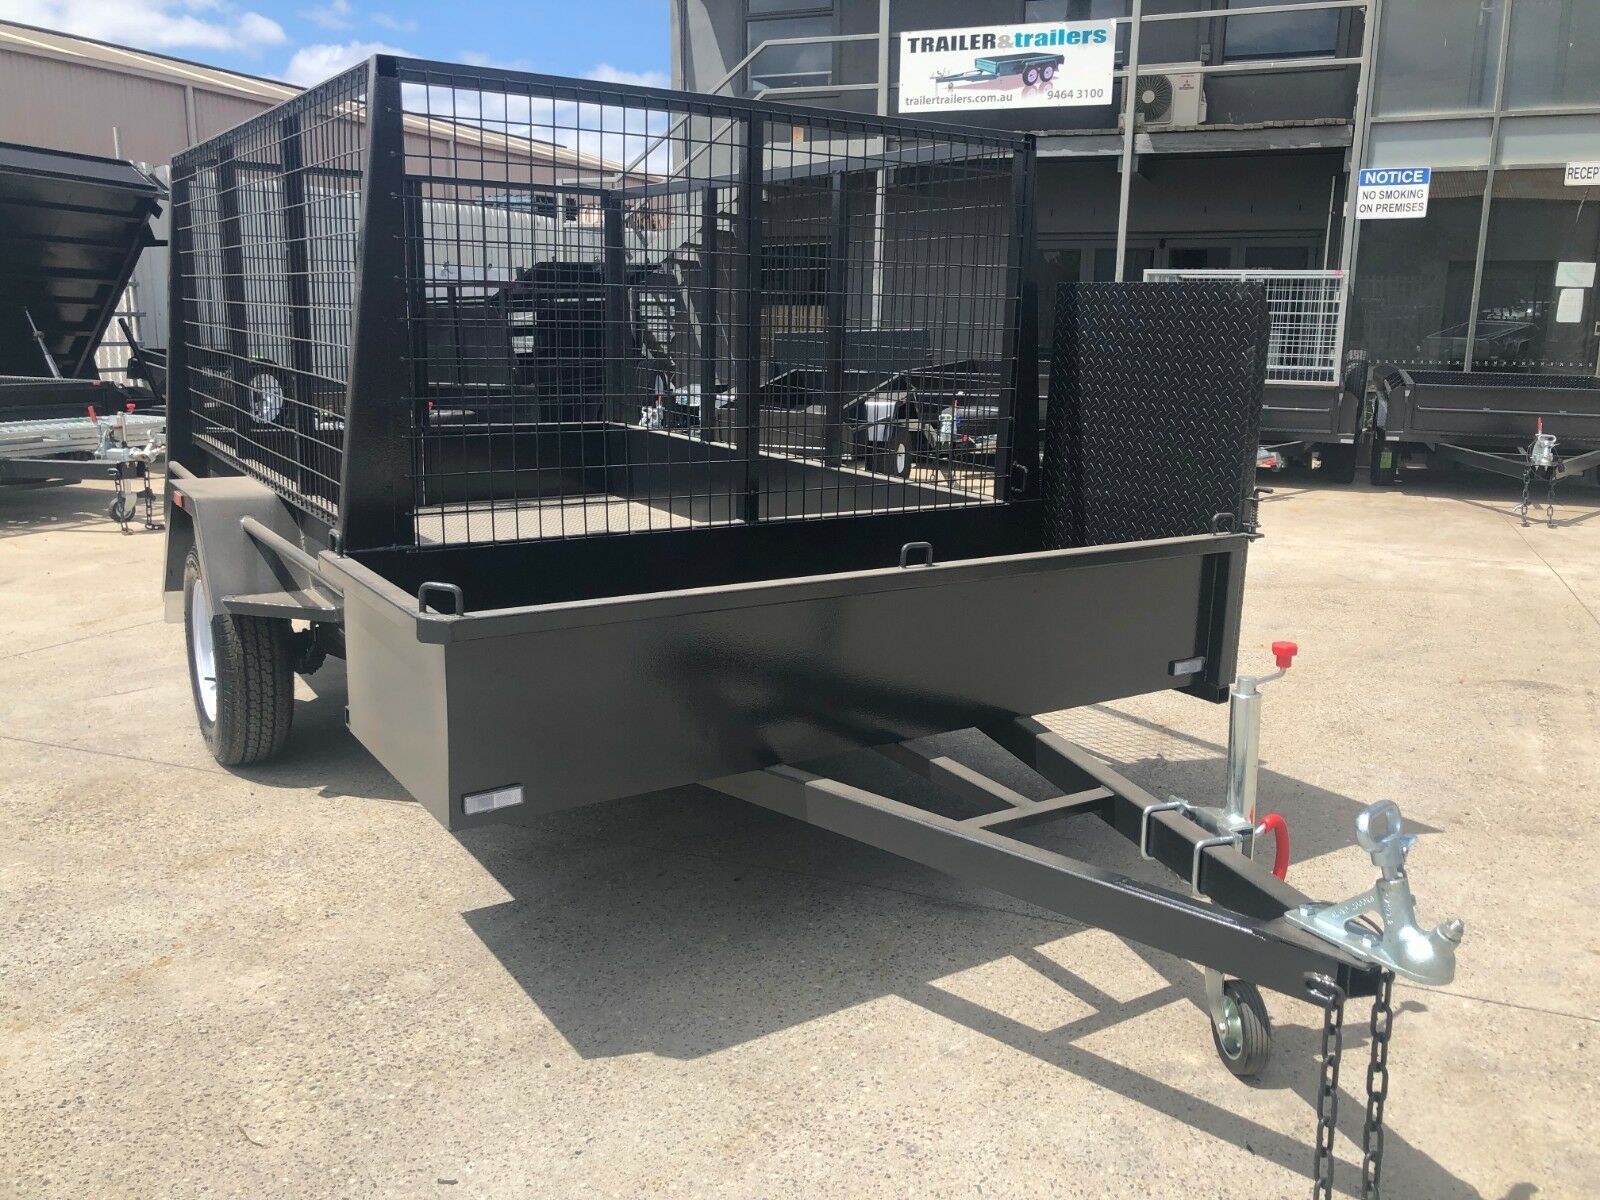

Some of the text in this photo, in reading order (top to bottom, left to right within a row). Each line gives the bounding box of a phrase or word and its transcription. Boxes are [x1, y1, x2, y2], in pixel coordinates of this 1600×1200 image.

[905, 94, 1013, 106] trailertrailers.com.au
[1047, 88, 1104, 100] 9464 3100
[1365, 170, 1424, 184] NOTICE
[1567, 166, 1600, 180] RECEP
[1362, 189, 1424, 200] NO SMOKING
[1359, 202, 1424, 213] ON PREMISES
